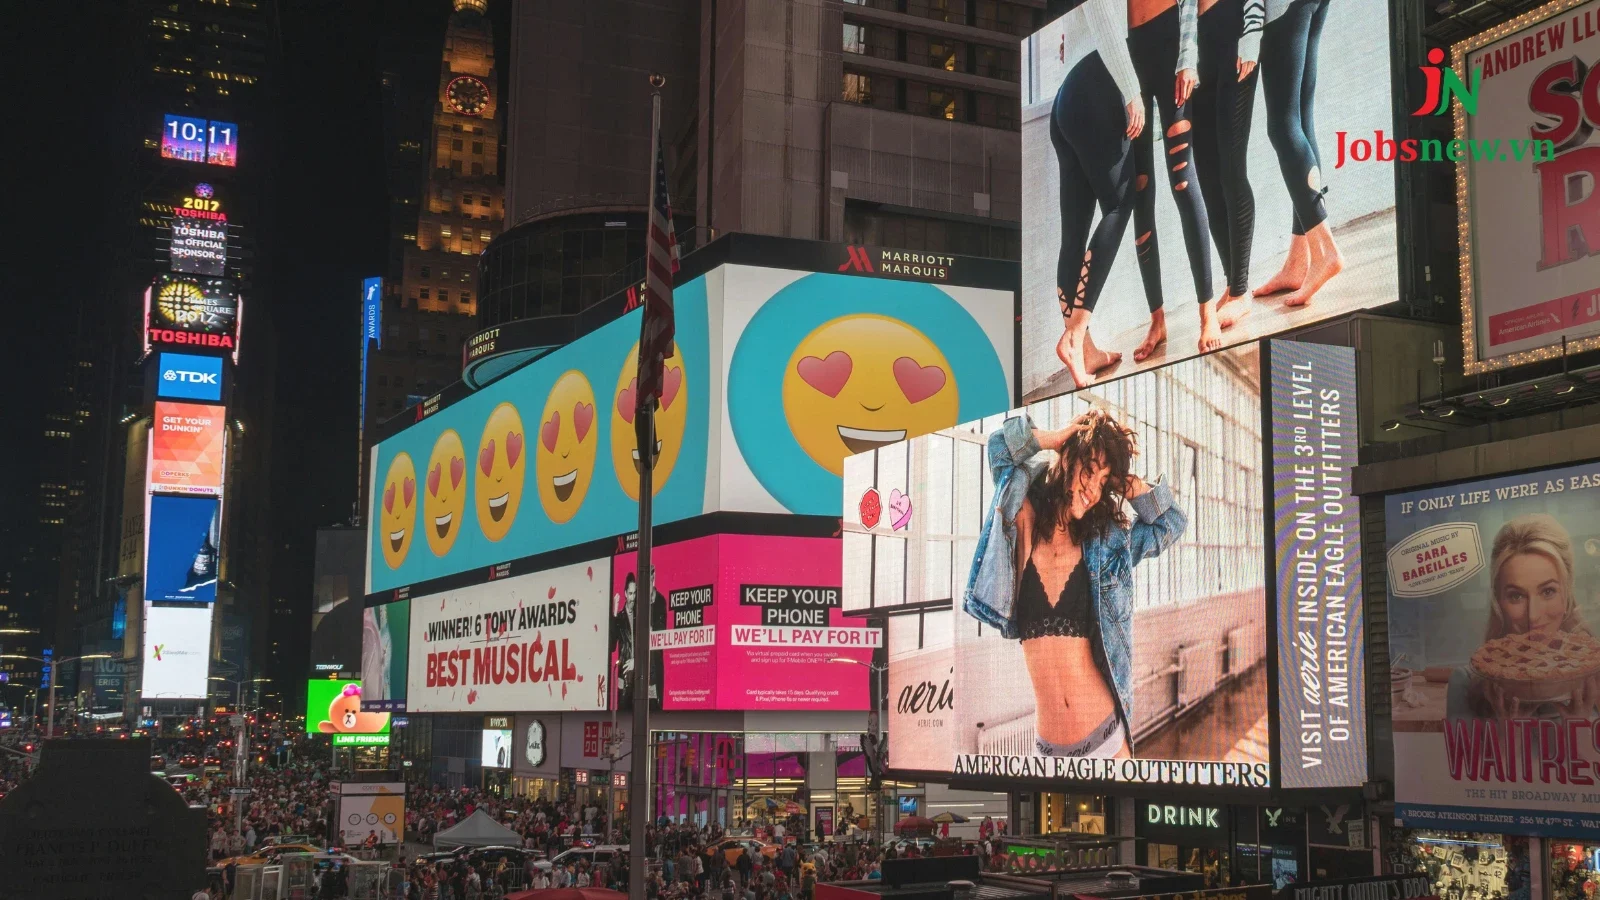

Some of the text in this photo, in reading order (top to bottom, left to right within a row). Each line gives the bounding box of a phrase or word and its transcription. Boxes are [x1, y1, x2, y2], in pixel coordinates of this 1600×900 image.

[168, 120, 231, 146] 10:11
[184, 198, 220, 212] 2017
[173, 208, 227, 221] TOSHIBA
[174, 226, 225, 240] TOSHIBA
[185, 238, 224, 250] OFFICIAL
[172, 248, 215, 259] SPONSOR
[882, 250, 955, 266] MARRIOTT
[881, 262, 947, 278] MARQUIS
[368, 304, 376, 338] AWARDS
[1498, 318, 1551, 336] American Airlines
[150, 328, 233, 348] TOSHIBA
[176, 370, 218, 384] TDK
[163, 416, 212, 426] GET YOUR
[1401, 501, 1414, 514] IF
[1418, 494, 1456, 512] ONLY
[1460, 490, 1491, 506] LIFE
[1496, 482, 1539, 500] WERE
[1544, 479, 1565, 494] AS
[1400, 530, 1459, 556] ORIGINAL MUSIC BY
[1416, 544, 1448, 564] SARA
[1292, 361, 1322, 770] VISIT aerie INSIDE ON THE 3RD LEVEL
[1320, 388, 1350, 742] OF AMERICAN EAGLE OUTFITTERS
[1402, 552, 1468, 582] BAREILLES
[670, 588, 712, 608] KEEP YOUR
[745, 586, 838, 605] KEEP YOUR
[675, 609, 702, 626] PHONE
[767, 608, 824, 624] PHONE
[428, 616, 472, 642] WINNER!
[474, 618, 482, 636] 6
[484, 609, 516, 636] TONY
[674, 630, 688, 646] PAY
[688, 628, 704, 644] FOR
[704, 628, 714, 644] IT
[792, 629, 824, 644] PAY
[827, 630, 860, 645] FOR
[864, 630, 880, 646] IT
[426, 638, 577, 688] BEST MUSICAL
[770, 650, 788, 658] prepaid
[918, 718, 944, 728] AERIE.COM
[953, 754, 1269, 786] AMERICAN EAGLE OUTFITTERS
[1465, 789, 1486, 799] THE
[1490, 790, 1508, 800] HIT
[1512, 790, 1576, 803] BROADWAY
[1148, 804, 1221, 828] DRINK
[1408, 810, 1436, 819] BROOKS
[1437, 811, 1477, 822] ATKINSON
[1479, 813, 1514, 824] THEATRE
[1520, 816, 1534, 825] 256
[1402, 876, 1431, 899] BBQ
